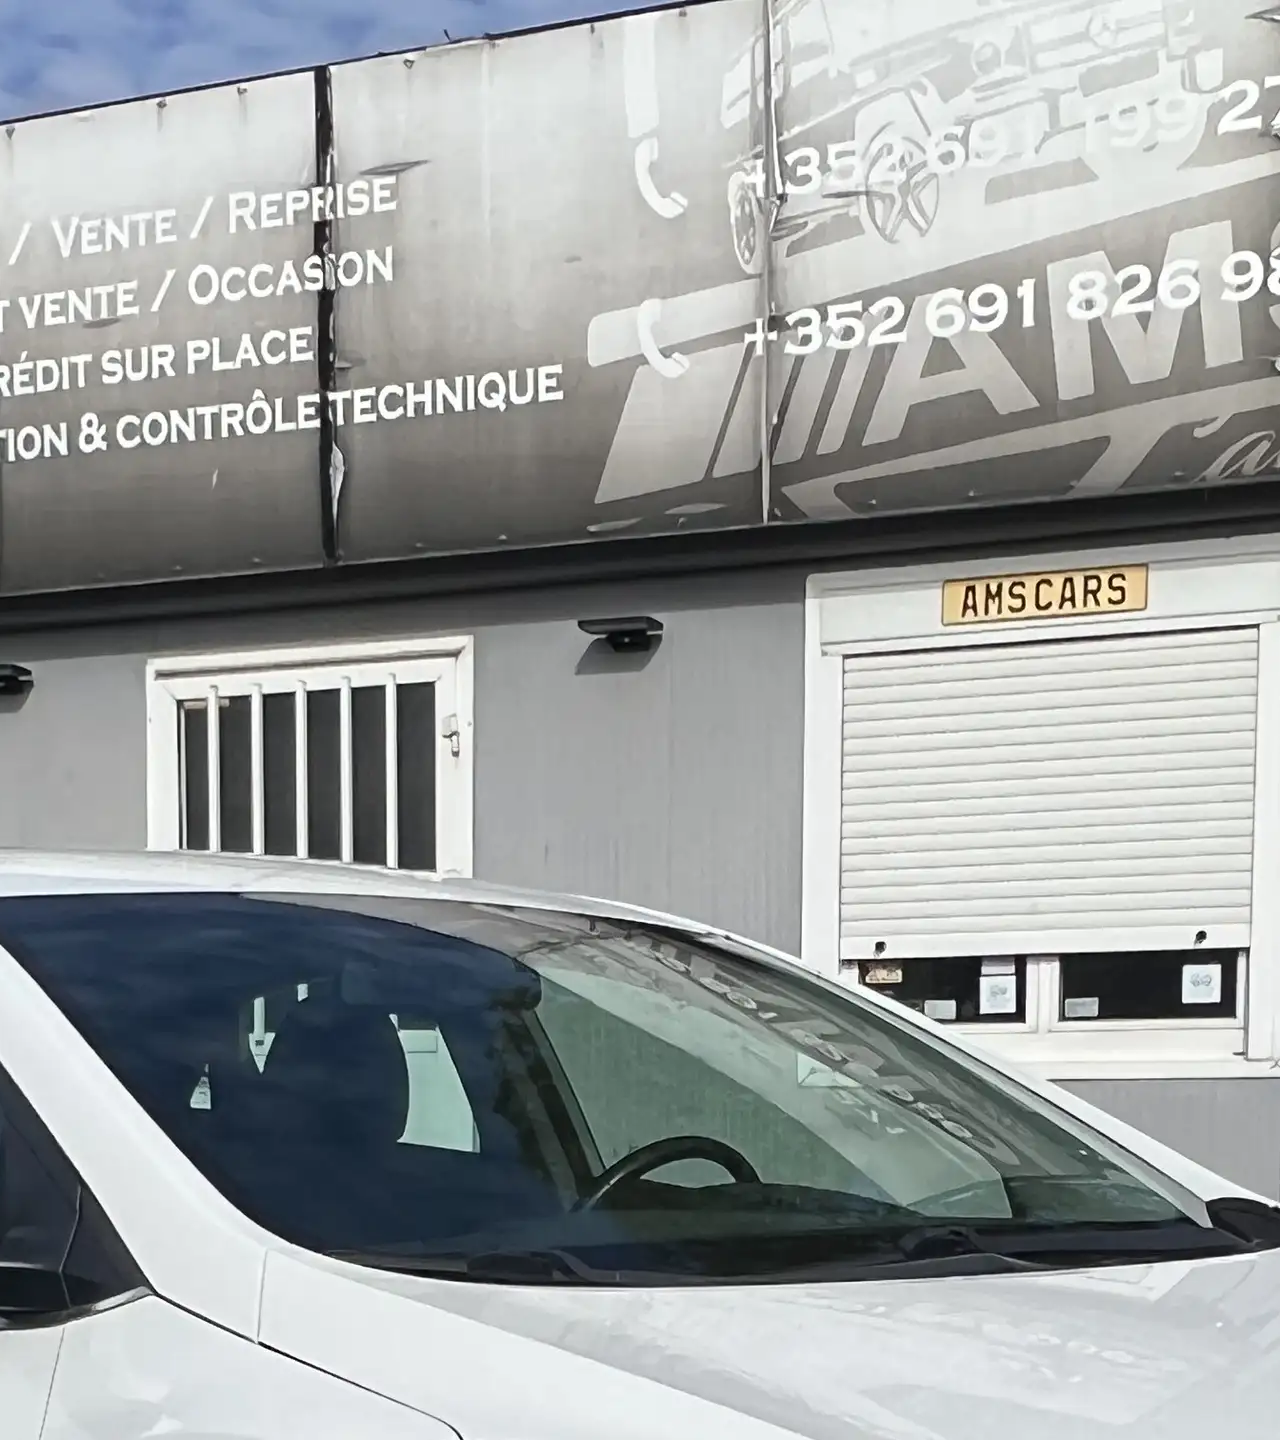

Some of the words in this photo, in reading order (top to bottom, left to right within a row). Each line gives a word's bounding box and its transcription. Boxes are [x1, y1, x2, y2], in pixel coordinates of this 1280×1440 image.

[51, 209, 176, 257] VENTE
[228, 176, 397, 233] REPRISE
[18, 280, 139, 329] VENTE
[188, 245, 393, 305] OCCASION
[744, 296, 907, 356] +352
[925, 278, 1036, 338] 691
[1066, 260, 1201, 321] 826
[101, 344, 175, 385] SUR
[186, 326, 314, 374] PLACE
[78, 412, 107, 453] &
[116, 389, 321, 448] CONTRÔLE
[325, 364, 564, 427] TECHNIQUE
[961, 573, 1127, 618] AMSCARS
